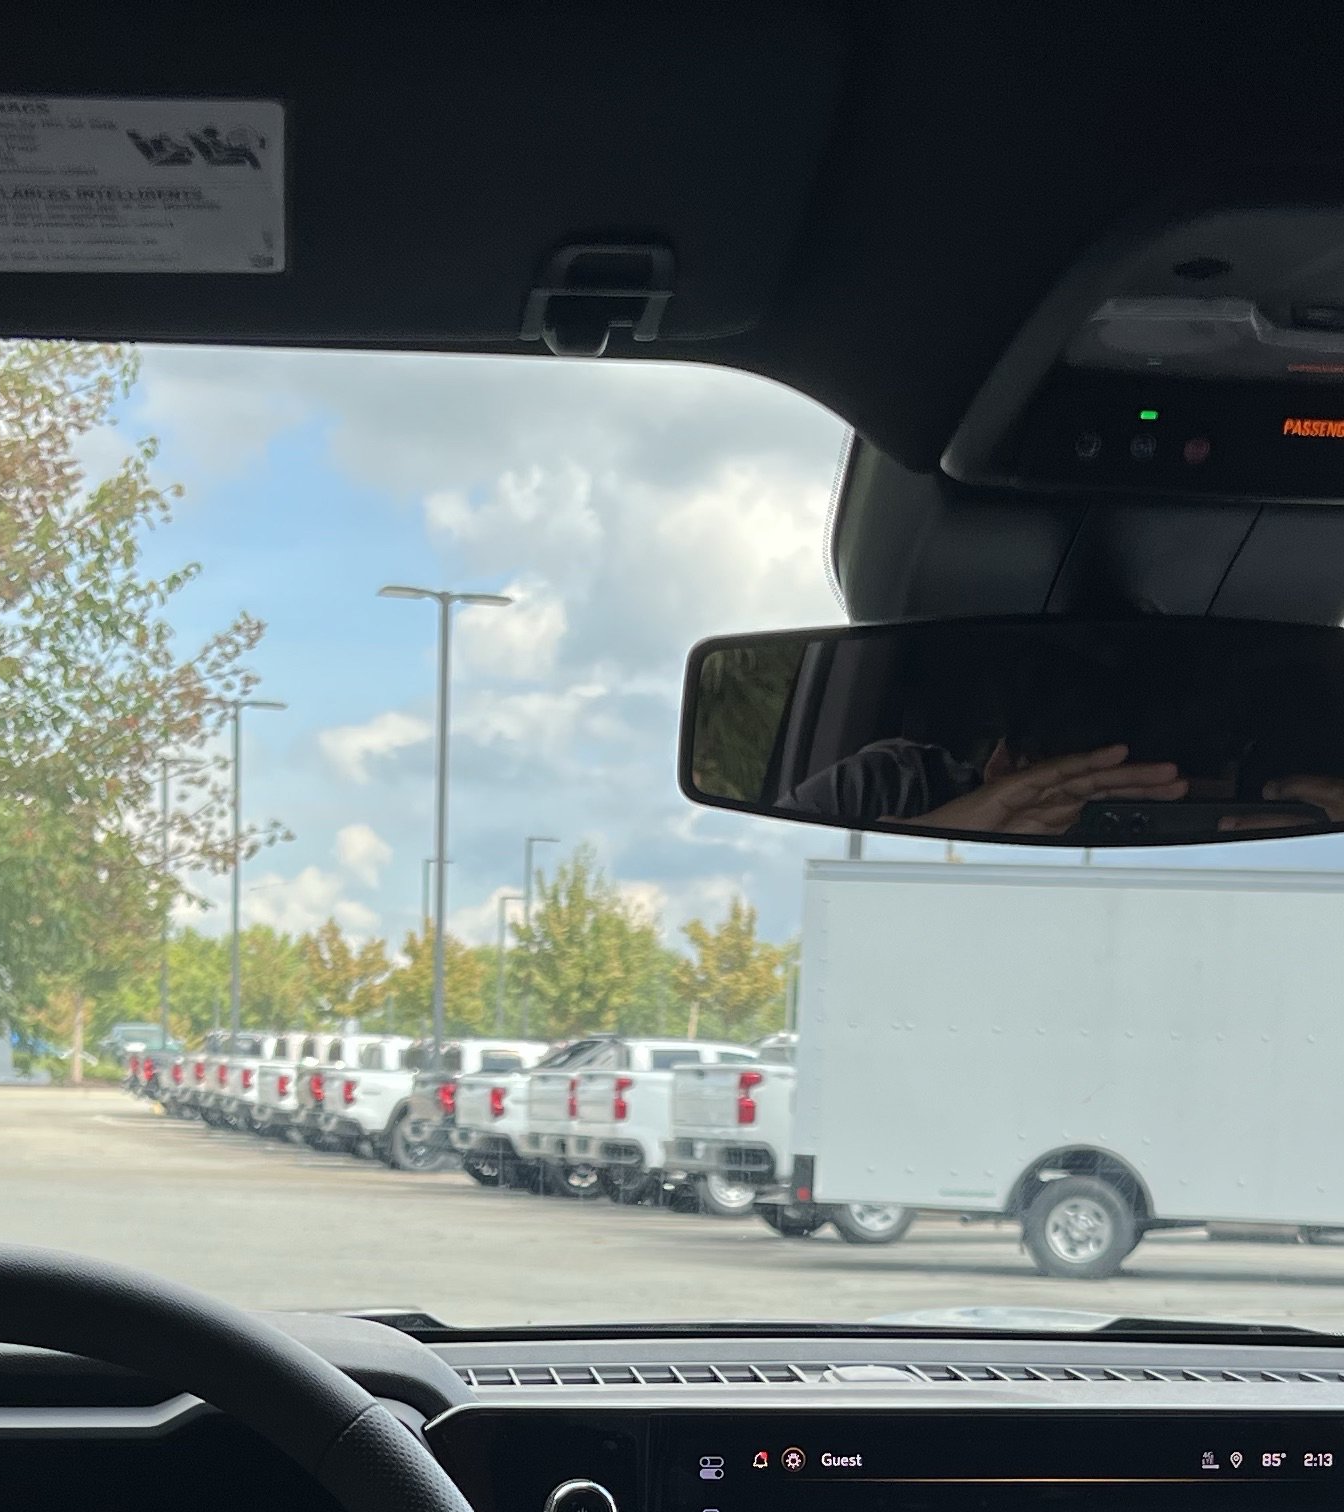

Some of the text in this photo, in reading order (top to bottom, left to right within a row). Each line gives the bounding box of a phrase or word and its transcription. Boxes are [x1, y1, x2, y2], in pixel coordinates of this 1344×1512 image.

[821, 1452, 863, 1467] Guest
[1261, 1452, 1287, 1467] 85°
[1304, 1453, 1333, 1467] 2:13
